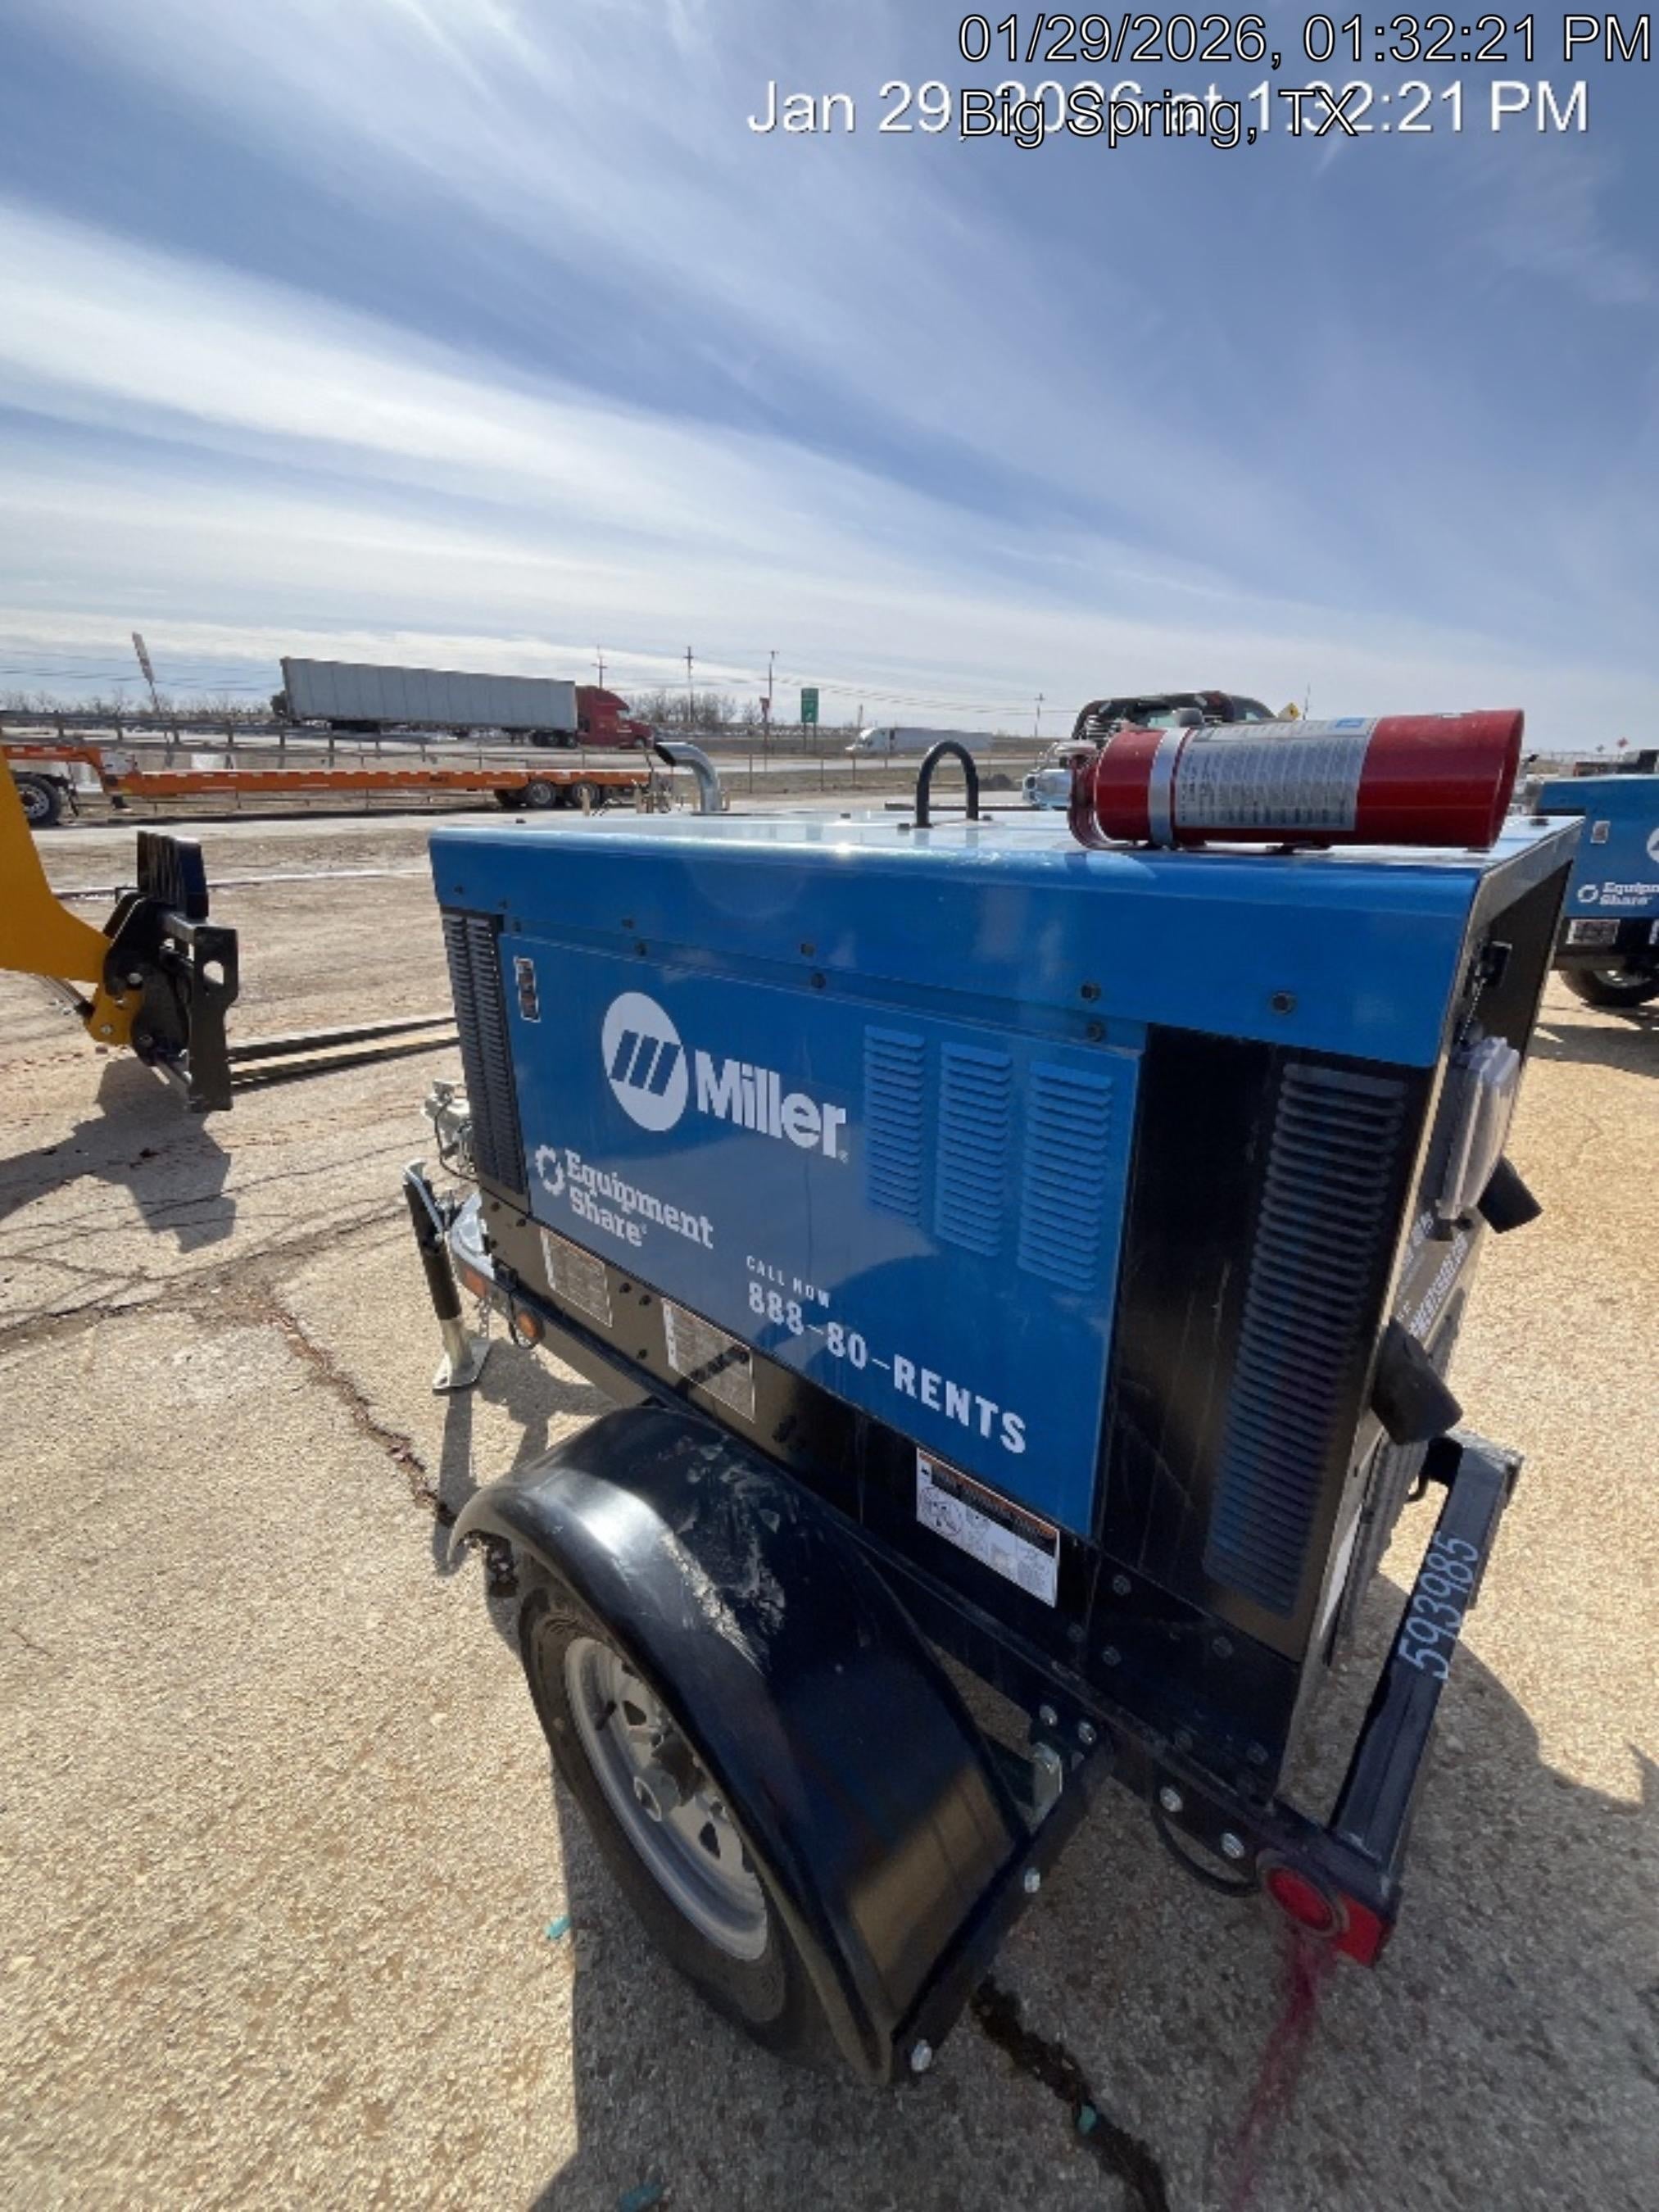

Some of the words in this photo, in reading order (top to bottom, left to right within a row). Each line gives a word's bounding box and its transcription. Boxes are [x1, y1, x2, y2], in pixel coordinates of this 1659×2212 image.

[694, 1049, 847, 1158] Miller
[564, 1149, 714, 1249] Equipment
[569, 1186, 642, 1247] Share
[746, 1255, 785, 1287] CALL
[792, 1277, 831, 1308] NOW
[748, 1282, 1026, 1453] 888-80-RENTS
[1398, 1530, 1479, 1680] 593985
